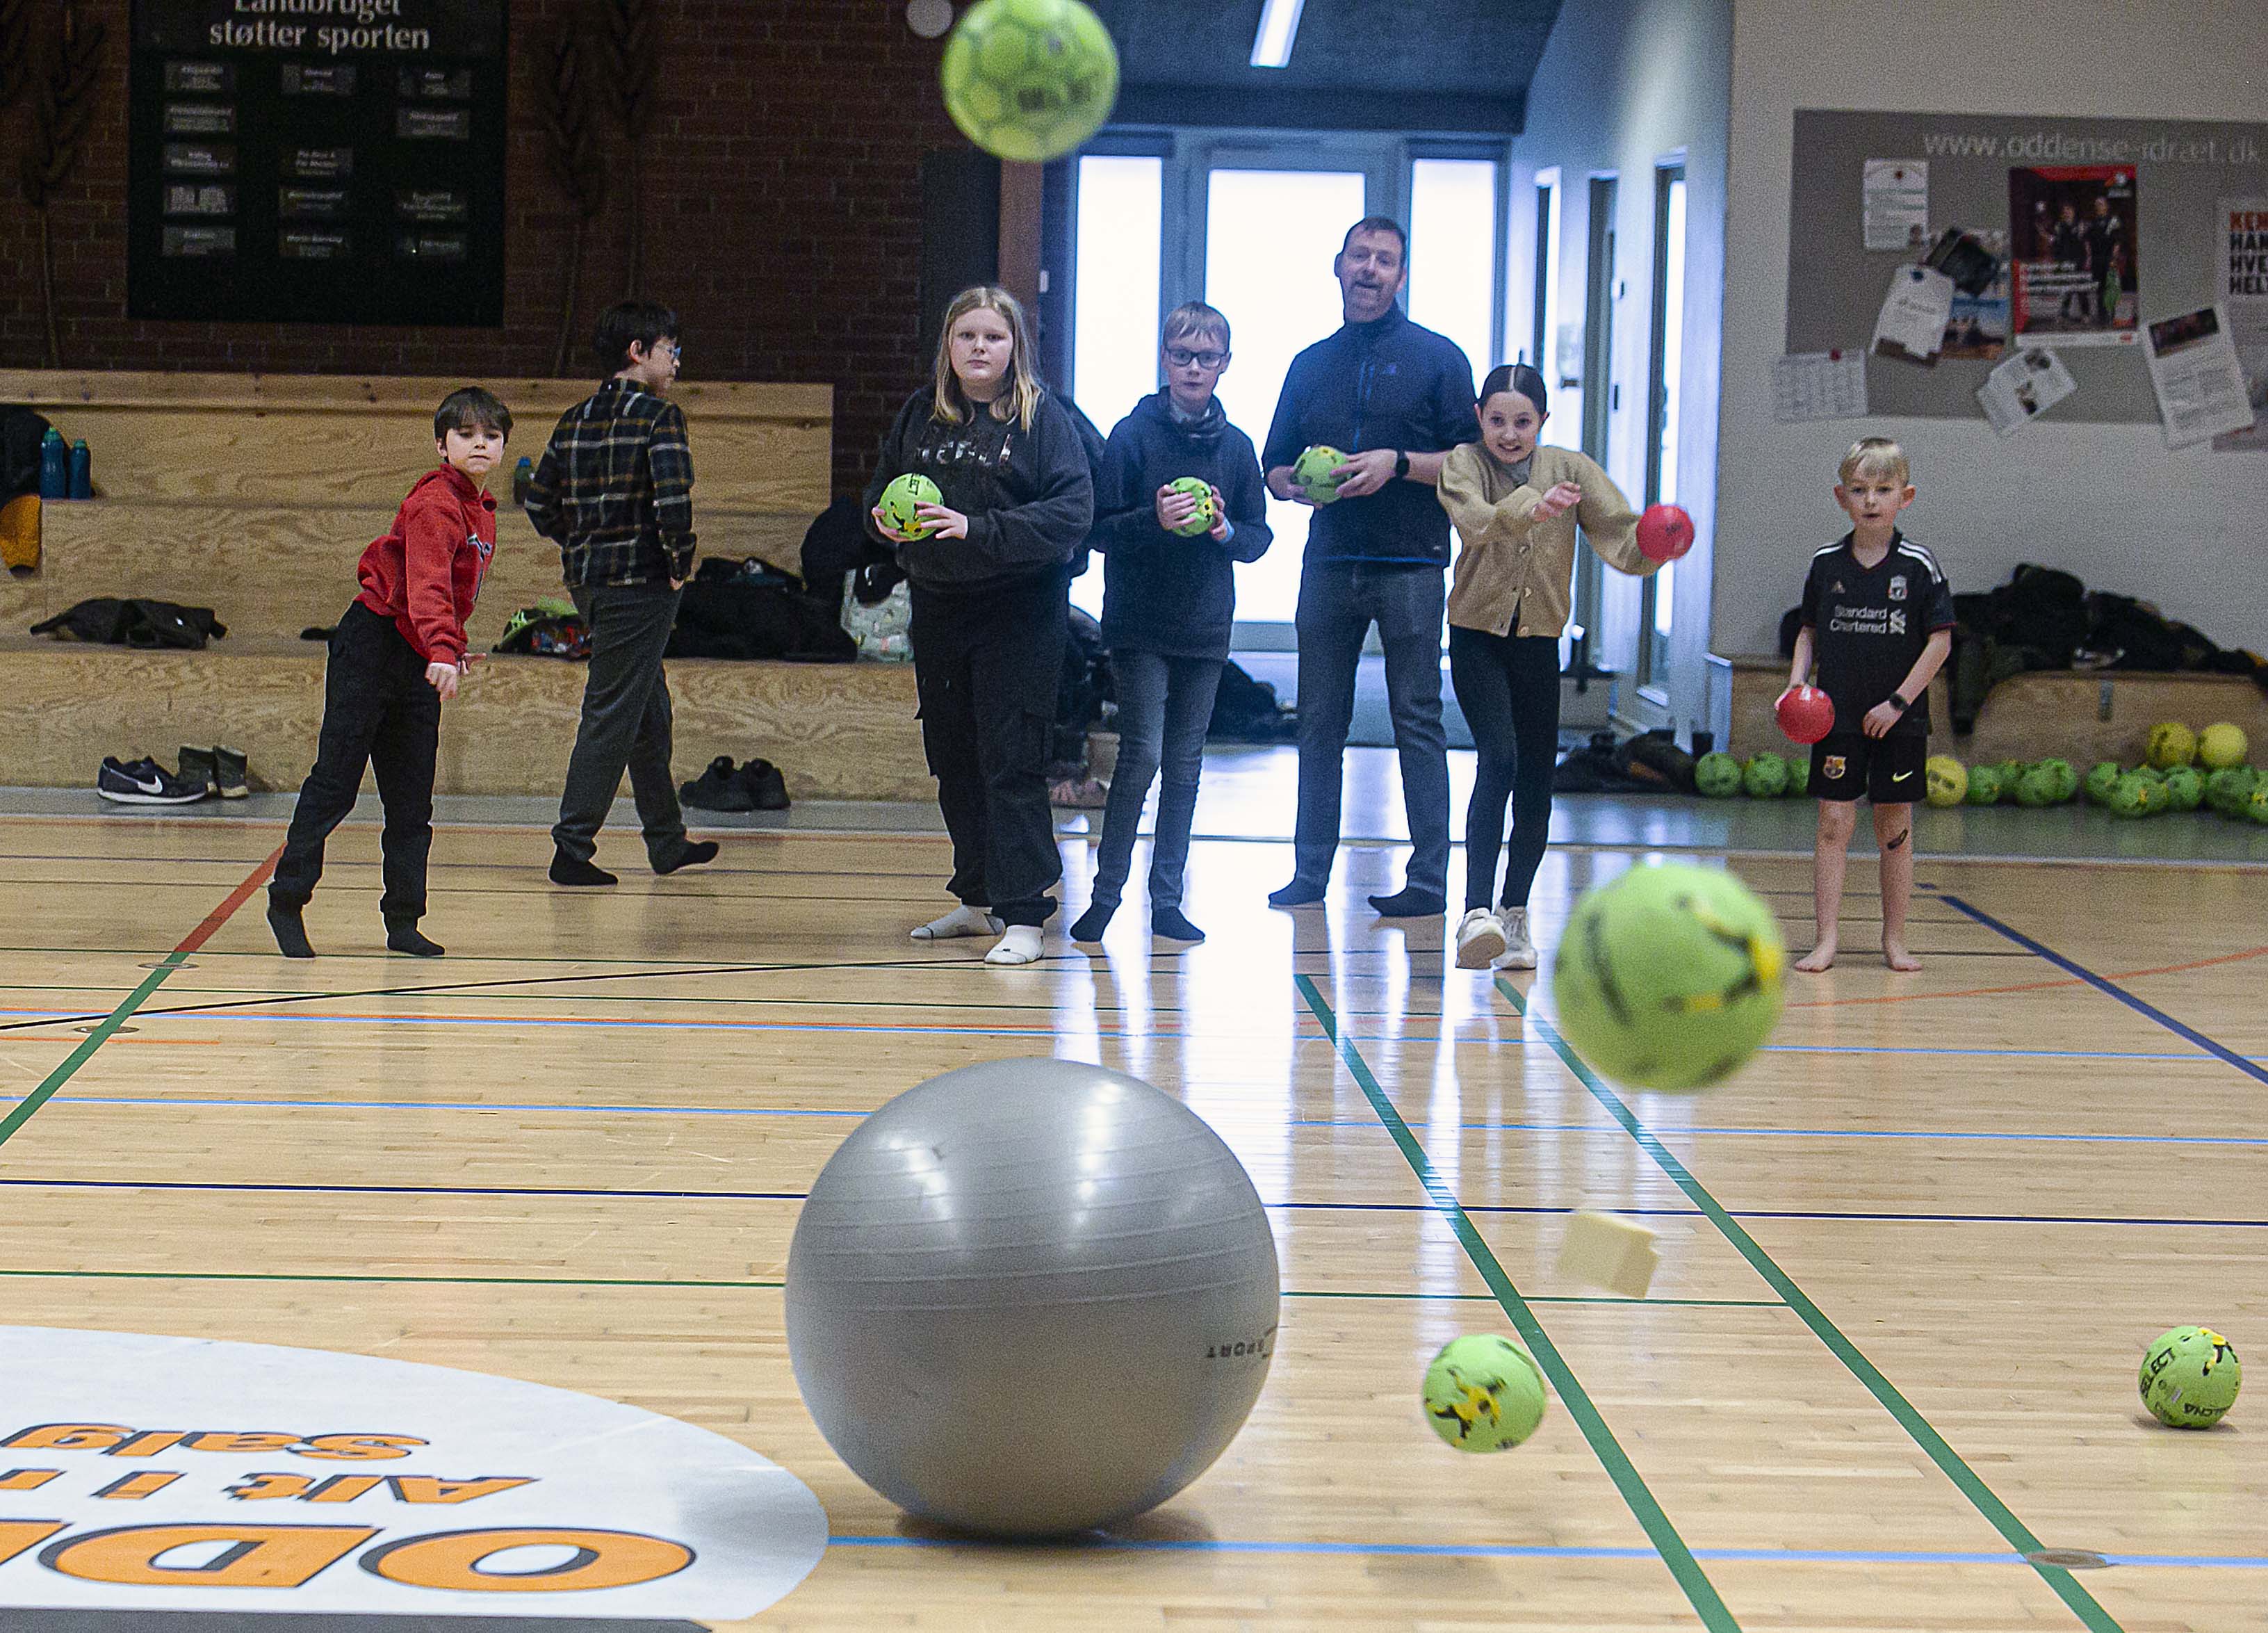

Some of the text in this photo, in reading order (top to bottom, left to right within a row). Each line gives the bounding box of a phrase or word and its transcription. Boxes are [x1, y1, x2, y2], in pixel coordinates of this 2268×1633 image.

[210, 19, 430, 56] støtter sporten
[1835, 604, 1888, 619] Standard
[1830, 619, 1887, 634] Chartered
[221, 1471, 542, 1505] Alt
